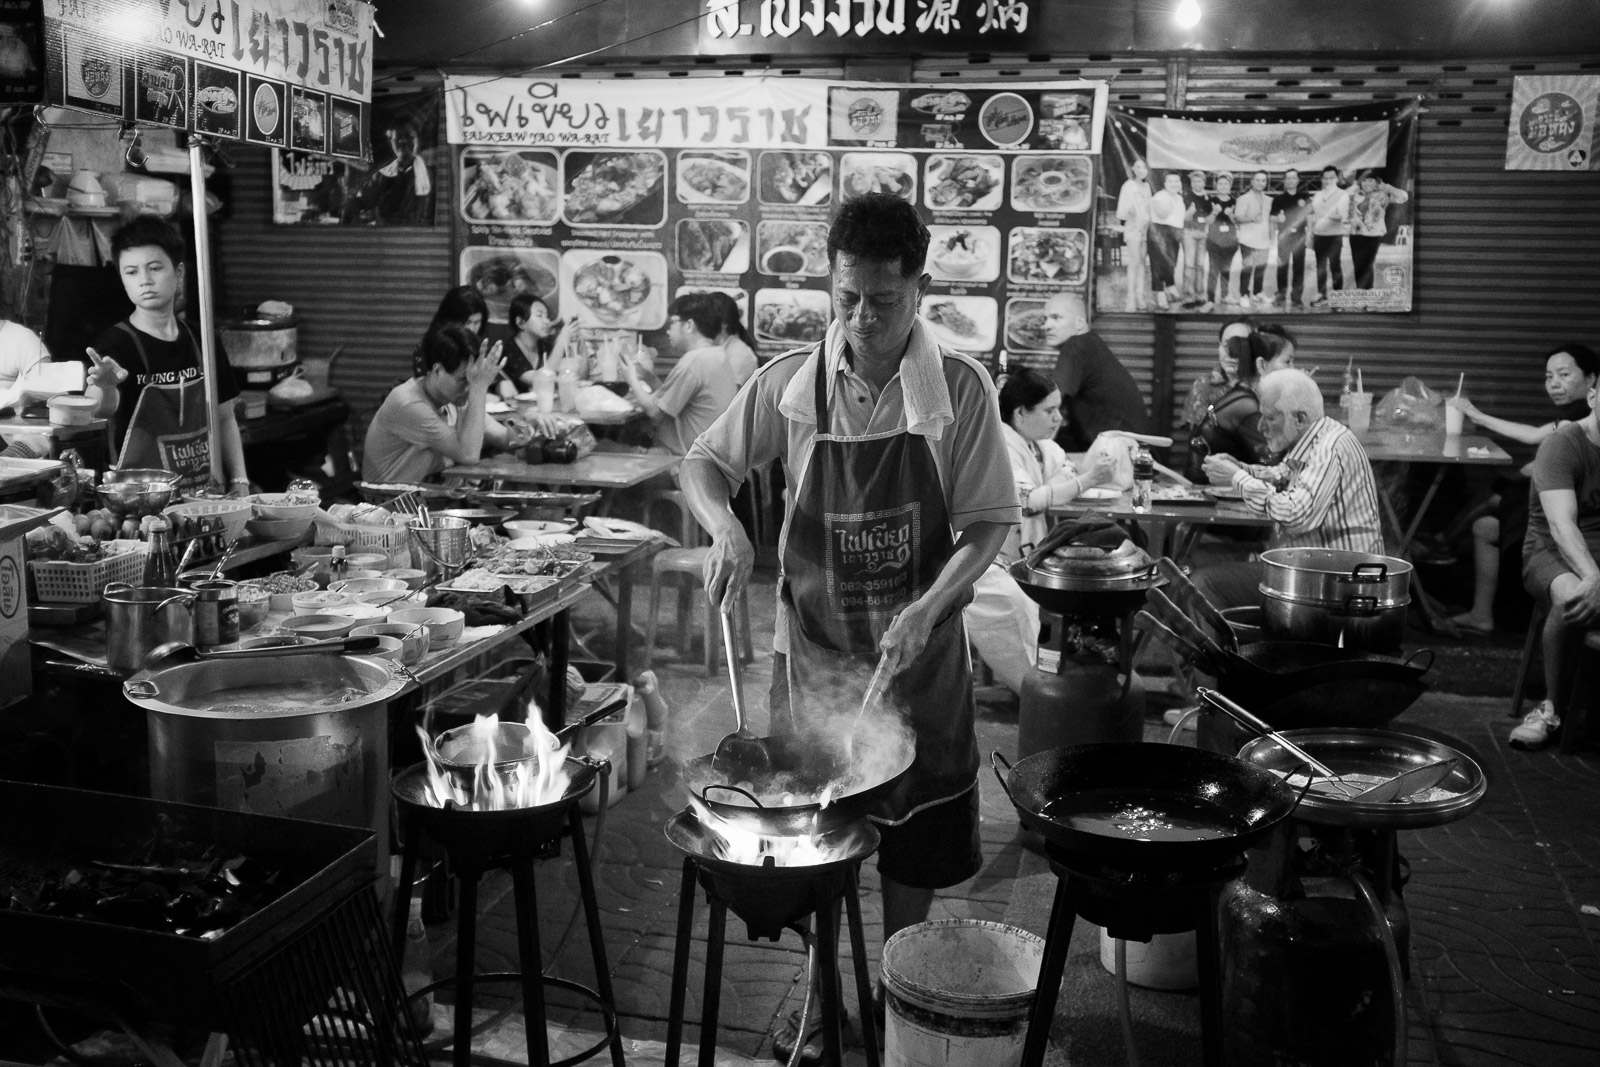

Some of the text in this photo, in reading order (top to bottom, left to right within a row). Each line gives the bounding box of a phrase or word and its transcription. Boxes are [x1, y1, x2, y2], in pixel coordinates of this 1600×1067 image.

[176, 29, 226, 59] WA-RAT
[455, 82, 610, 130] ไฟเขียว
[616, 104, 814, 145] เยาวราช
[558, 131, 610, 144] WA-RAT
[834, 522, 910, 553] ไฟเขียว
